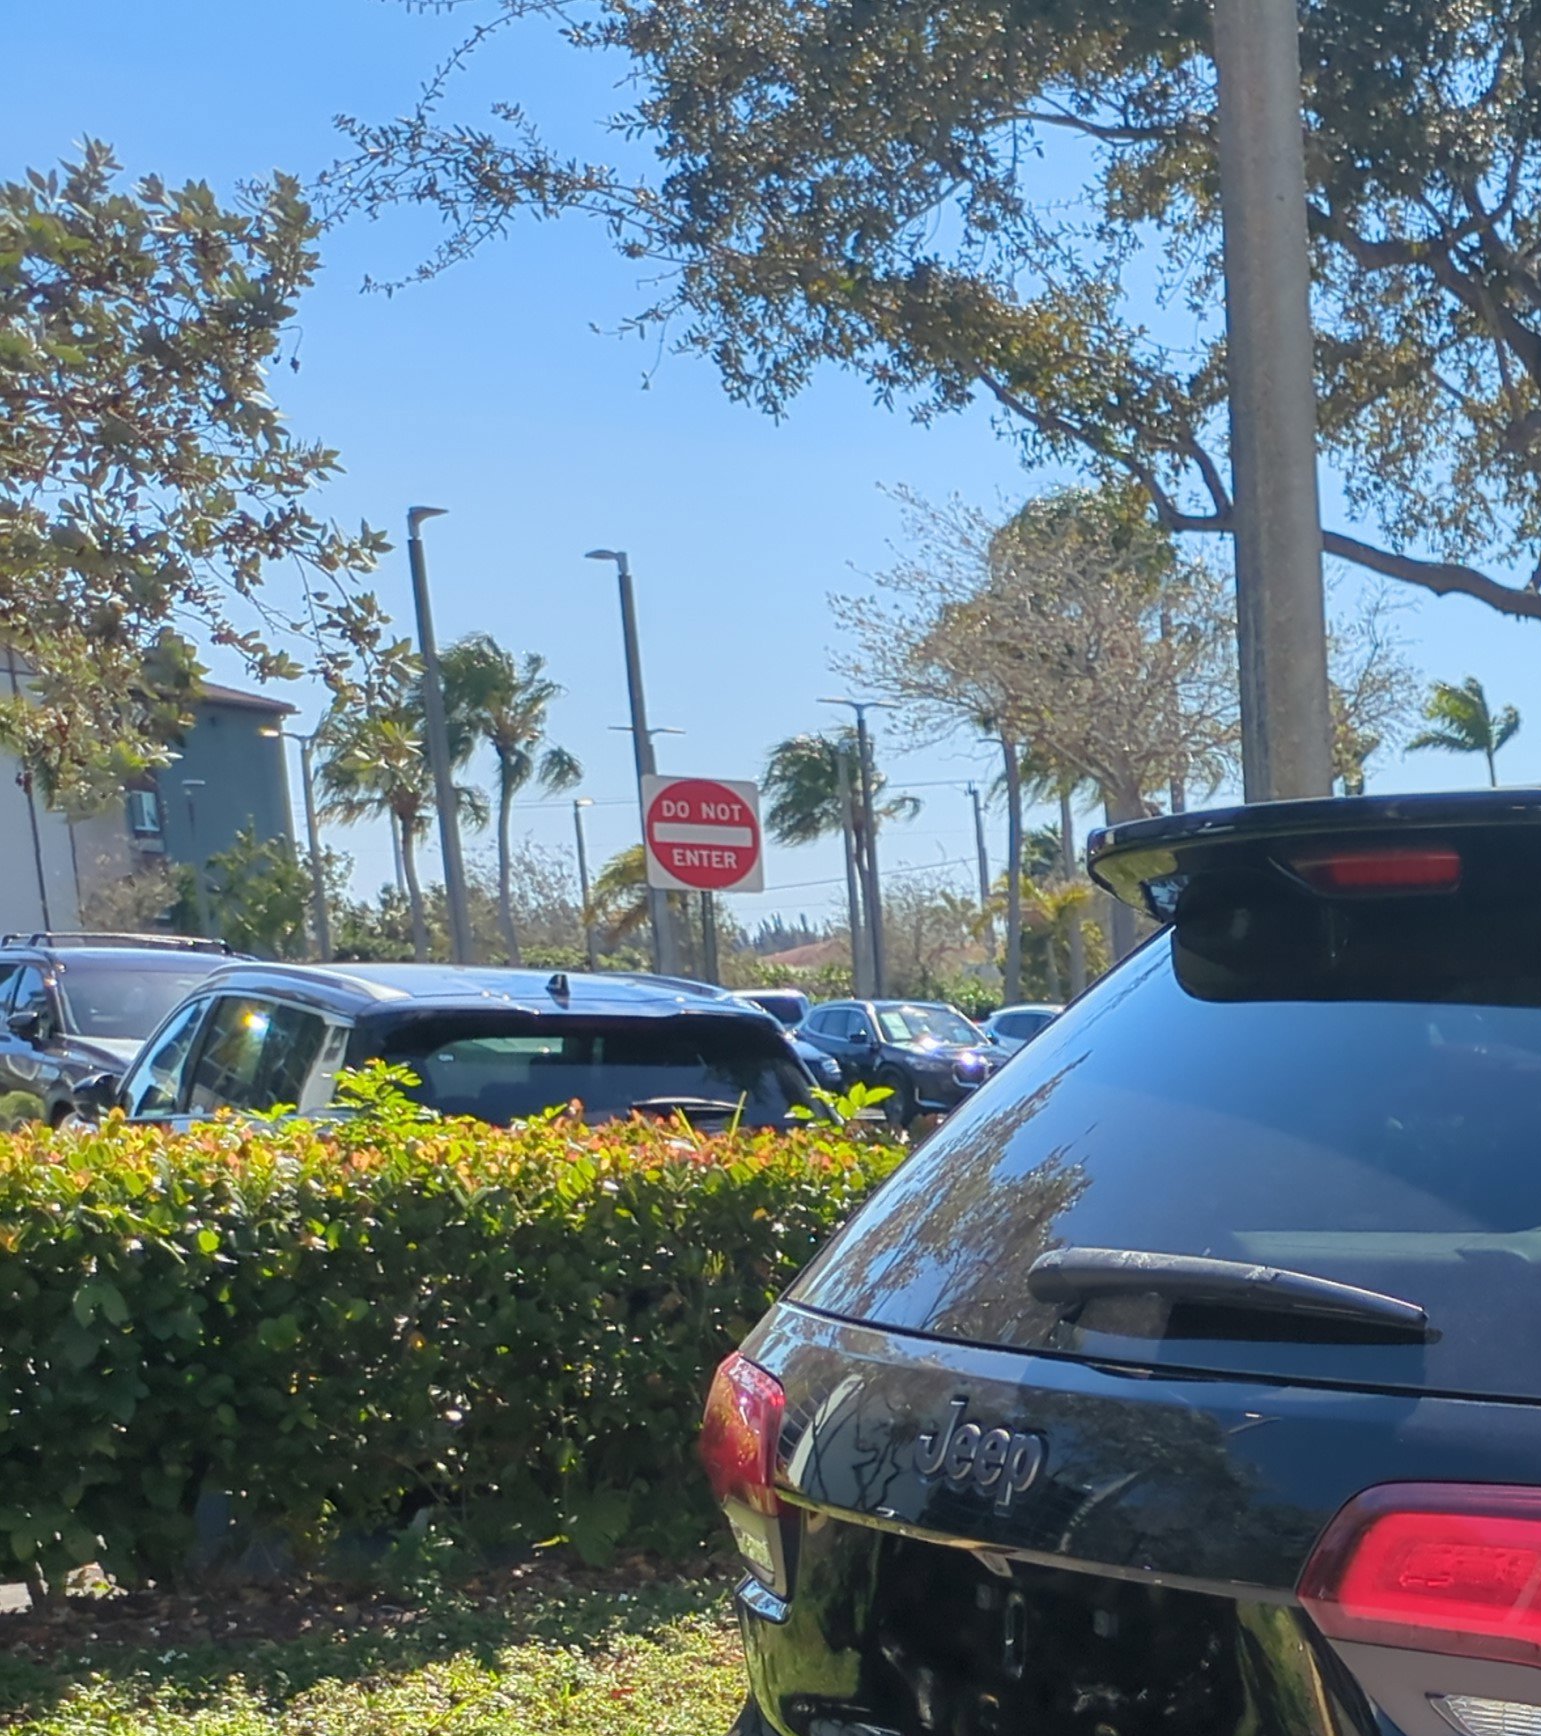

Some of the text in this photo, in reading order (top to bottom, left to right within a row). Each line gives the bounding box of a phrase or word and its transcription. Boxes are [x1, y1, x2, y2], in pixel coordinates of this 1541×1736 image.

[661, 800, 742, 821] DO NOT
[672, 848, 738, 869] ENTER
[916, 1396, 1044, 1506] Jeep
